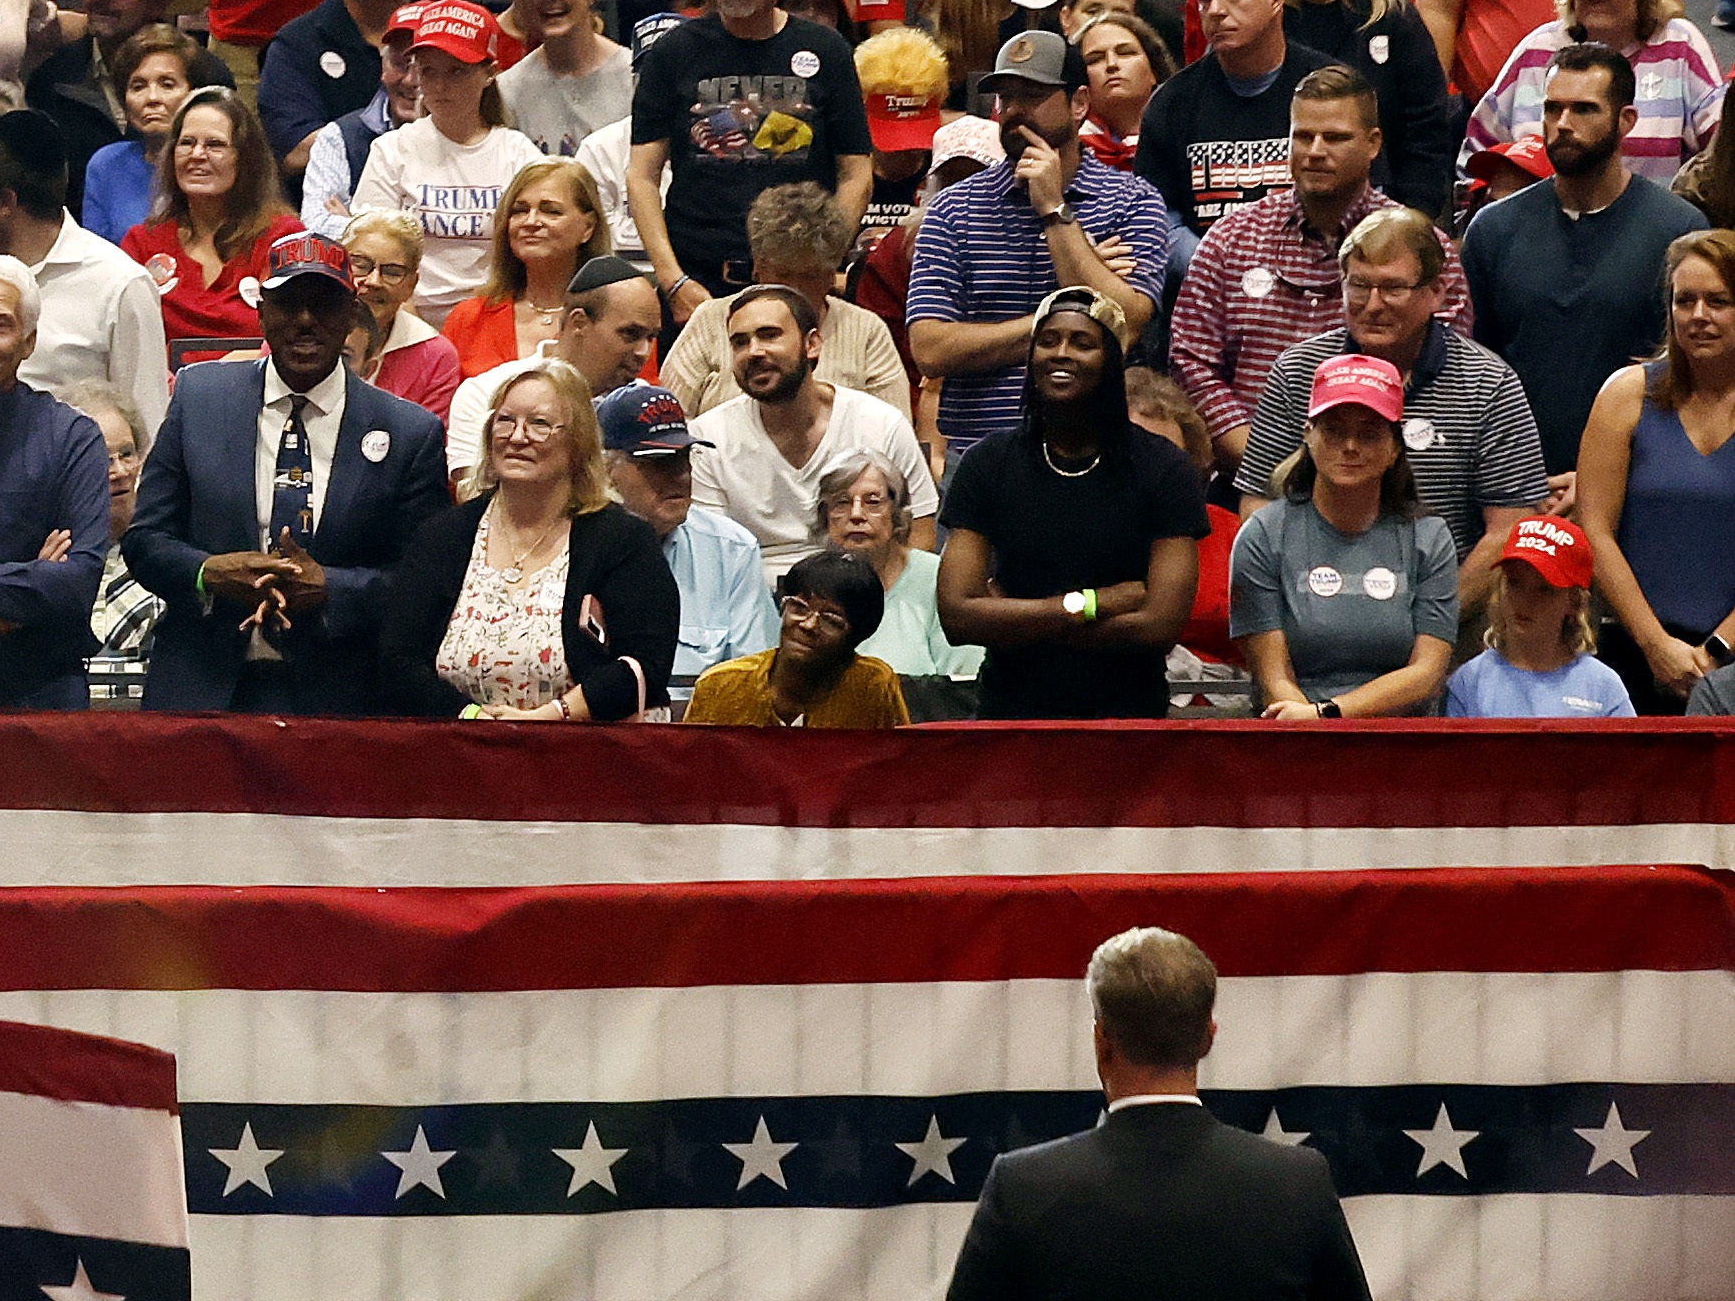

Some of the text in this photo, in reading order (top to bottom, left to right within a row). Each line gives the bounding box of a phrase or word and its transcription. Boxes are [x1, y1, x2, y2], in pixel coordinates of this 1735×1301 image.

[444, 23, 478, 42] AGAIN
[698, 75, 807, 103] NEVER
[417, 183, 503, 206] TRUMP
[275, 237, 345, 271] TRUMP
[1515, 534, 1557, 557] 2024
[1517, 520, 1575, 547] TRUMP
